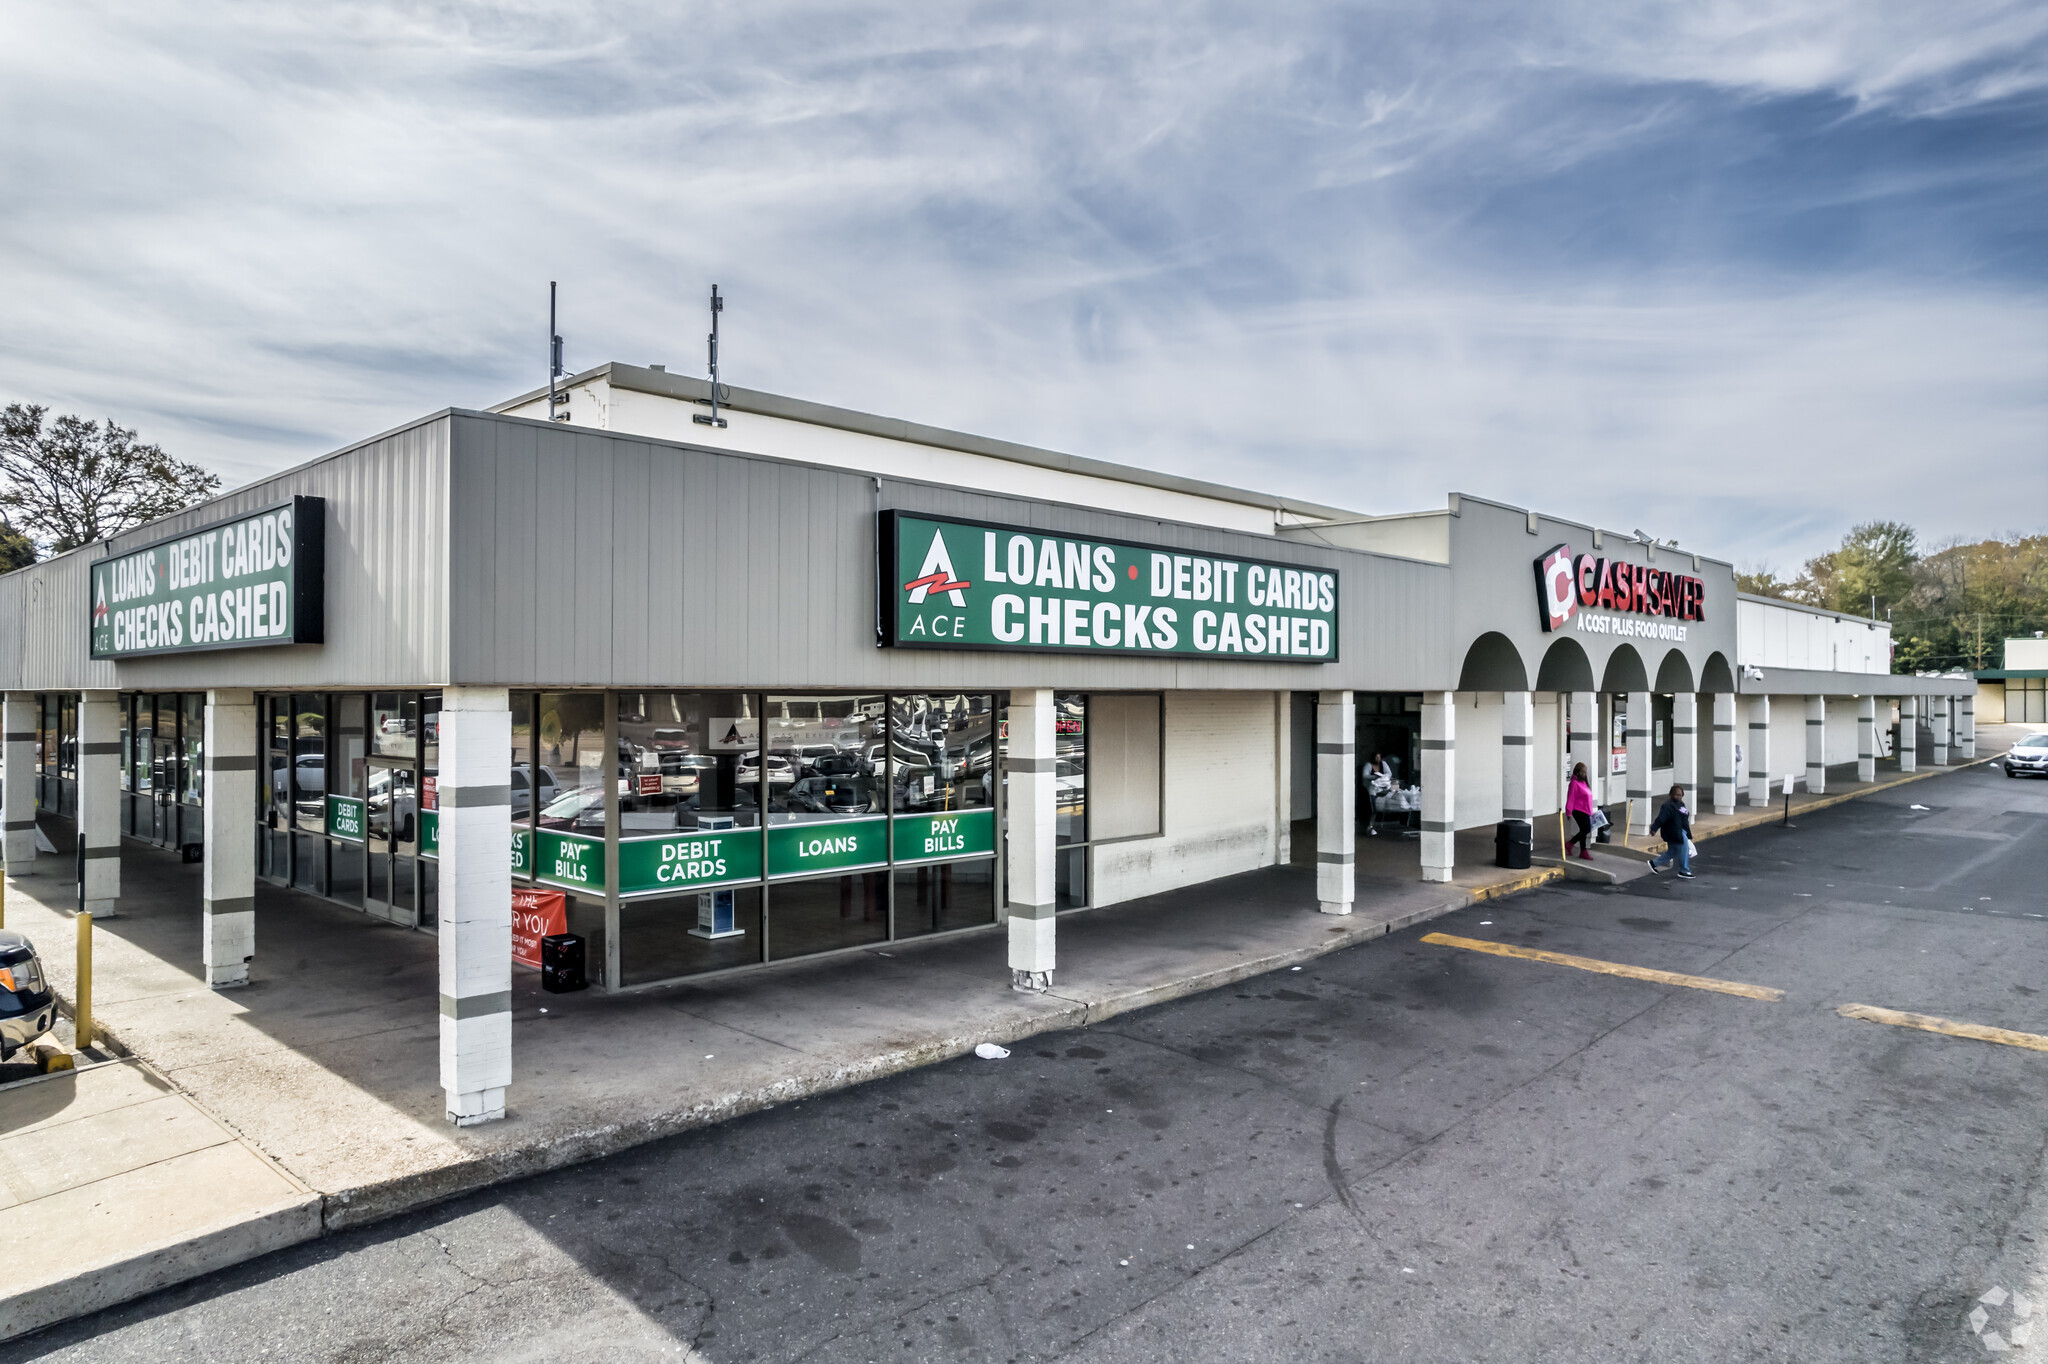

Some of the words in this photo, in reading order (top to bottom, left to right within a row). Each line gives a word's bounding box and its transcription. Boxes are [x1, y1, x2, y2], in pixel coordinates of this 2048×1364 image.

[112, 551, 156, 603] LOANS
[169, 532, 217, 591] DEBIT
[221, 509, 292, 580] CARDS
[984, 531, 1116, 593] LOANS
[1151, 553, 1239, 604] DEBIT
[1247, 565, 1335, 613] CARDS
[1575, 553, 1706, 622] CASHSAVER
[113, 599, 183, 651] CHECKS
[189, 580, 287, 644] CASHED
[909, 613, 966, 638] ACE
[991, 593, 1179, 649] CHECKS
[1192, 609, 1330, 657] CASHED
[1577, 613, 1585, 631] A
[1585, 613, 1611, 634] COST
[1611, 617, 1634, 637] PLUS
[1635, 620, 1658, 639] FOOD
[1658, 624, 1687, 642] OUTLET
[95, 634, 109, 651] ACE
[338, 803, 357, 817] DEBIT
[336, 818, 359, 833] CARDS
[931, 819, 958, 835] PAY
[560, 841, 582, 860] PAY
[661, 840, 722, 862] DEBIT
[799, 836, 857, 857] LOANS
[924, 835, 964, 853] BILLS
[555, 860, 587, 882] BILLS
[656, 859, 727, 882] CARDS
[519, 894, 538, 909] THE
[523, 913, 549, 936] YOU
